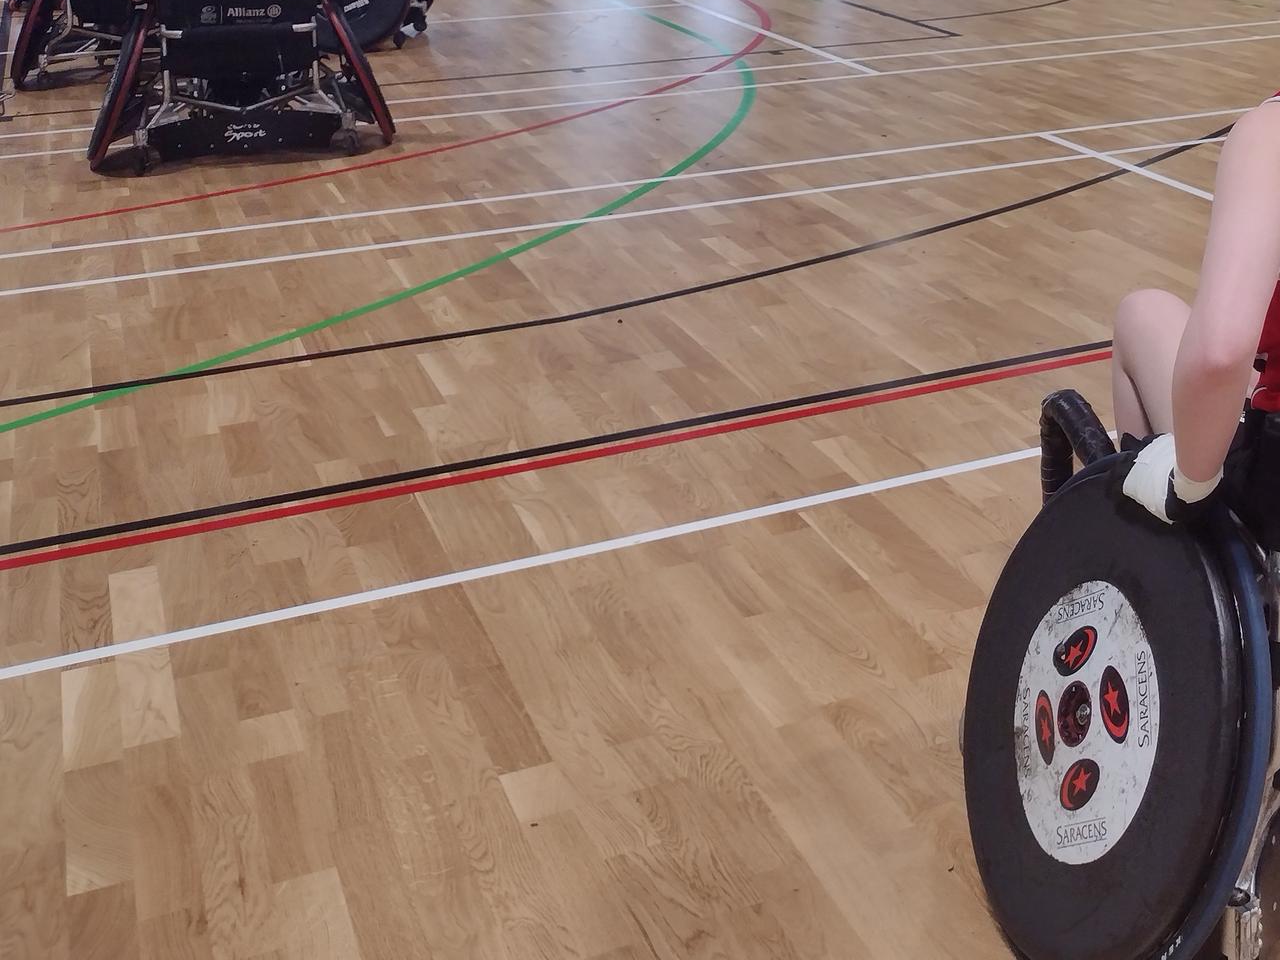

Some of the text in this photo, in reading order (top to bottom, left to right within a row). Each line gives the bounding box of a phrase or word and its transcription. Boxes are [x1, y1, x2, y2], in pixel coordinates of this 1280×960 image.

[226, 7, 266, 17] Allianz
[224, 129, 267, 143] Sport
[1057, 590, 1106, 622] SARACENS
[1136, 649, 1151, 749] SARACENS
[1021, 686, 1034, 780] SARACENS
[1056, 819, 1108, 846] SARACENS
